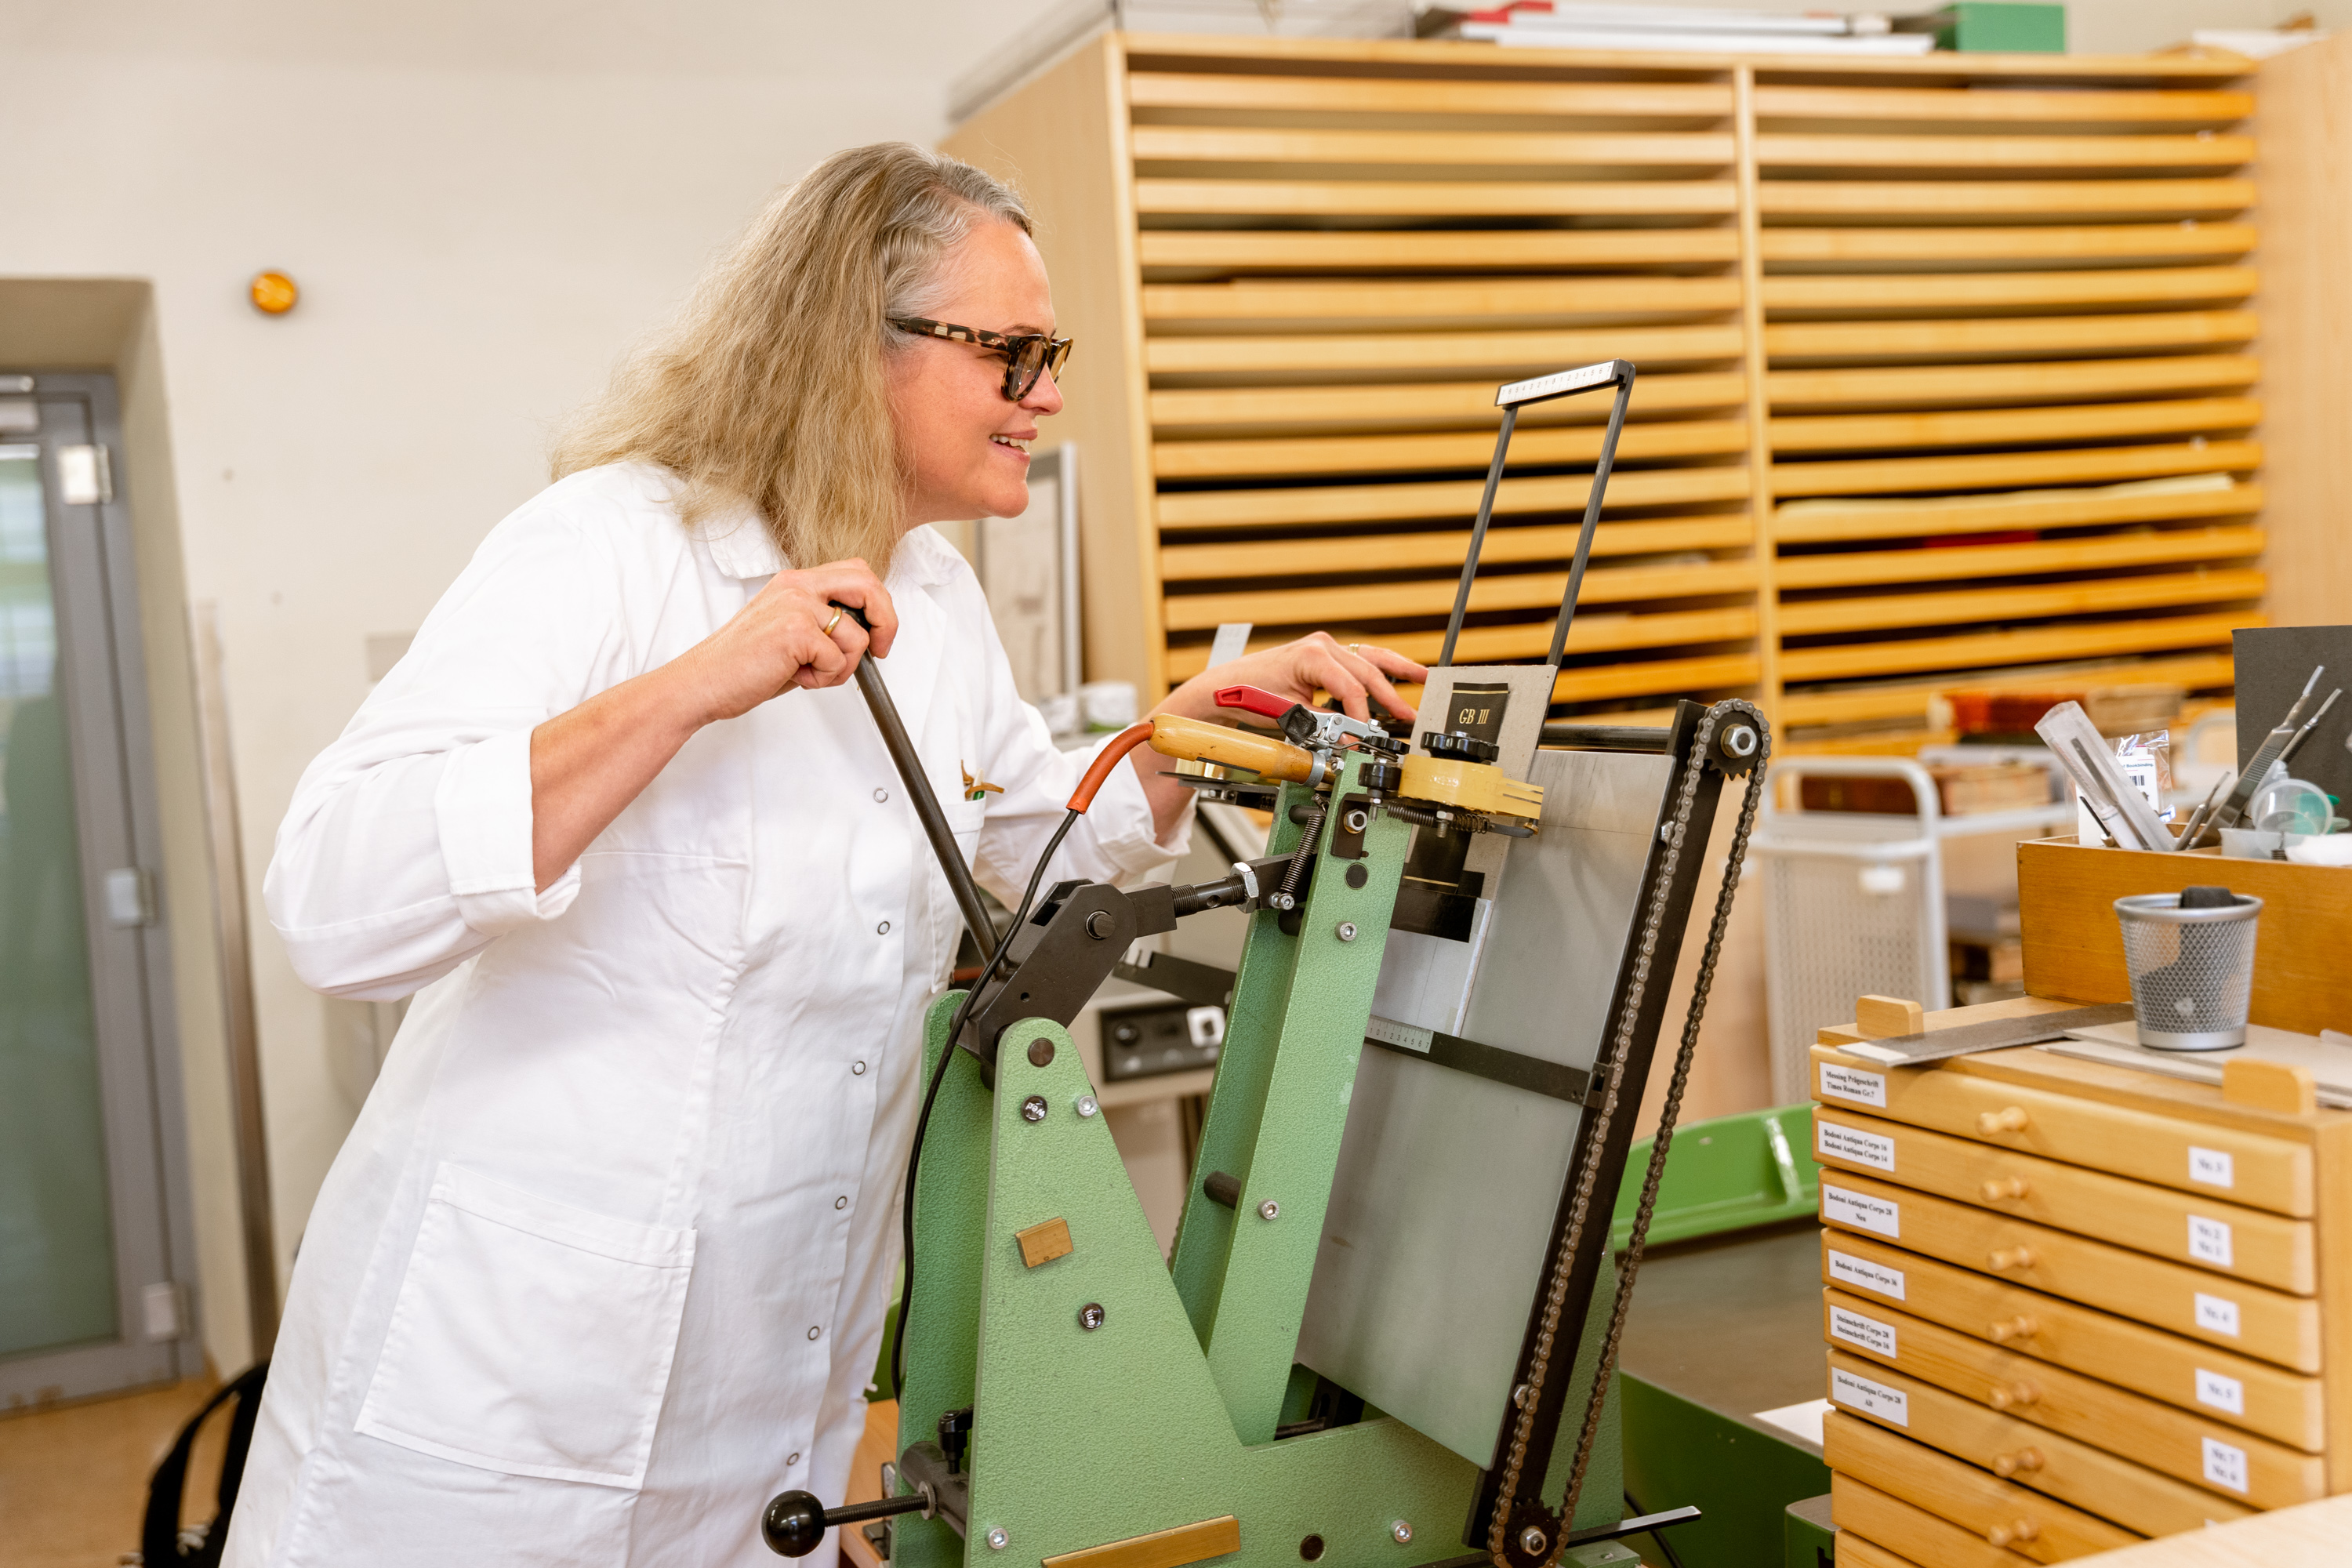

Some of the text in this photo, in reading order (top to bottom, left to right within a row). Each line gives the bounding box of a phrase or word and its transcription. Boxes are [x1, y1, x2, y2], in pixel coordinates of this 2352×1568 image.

[1459, 709, 1490, 724] GB III
[1826, 1071, 1878, 1087] Messing Prägeschrift
[1827, 1081, 1842, 1091] Times
[1843, 1085, 1861, 1095] Roman
[1025, 1102, 1046, 1117] Wed
[1824, 1129, 1842, 1139] Bodoni
[1843, 1134, 1863, 1145] Antiqua
[1864, 1139, 1879, 1151] Corps
[1824, 1140, 1842, 1150] Bodoni
[1843, 1145, 1863, 1156] Antiqua
[1864, 1150, 1880, 1161] Corps
[1828, 1192, 1846, 1203] Bodoni
[1847, 1198, 1867, 1209] Antiqua
[1868, 1203, 1885, 1214] Corps
[1856, 1213, 1866, 1221] Neu
[1835, 1260, 1853, 1271] Bodoni
[1853, 1266, 1874, 1278] Antiqua
[1875, 1272, 1890, 1284] Corps
[1836, 1314, 1865, 1330] Steinschrift
[1866, 1325, 1882, 1336] Corps
[1837, 1325, 1865, 1341] Steinschrift
[1867, 1335, 1882, 1347] Corps
[1837, 1375, 1901, 1404] Bodoni Antiqua Corps 28
